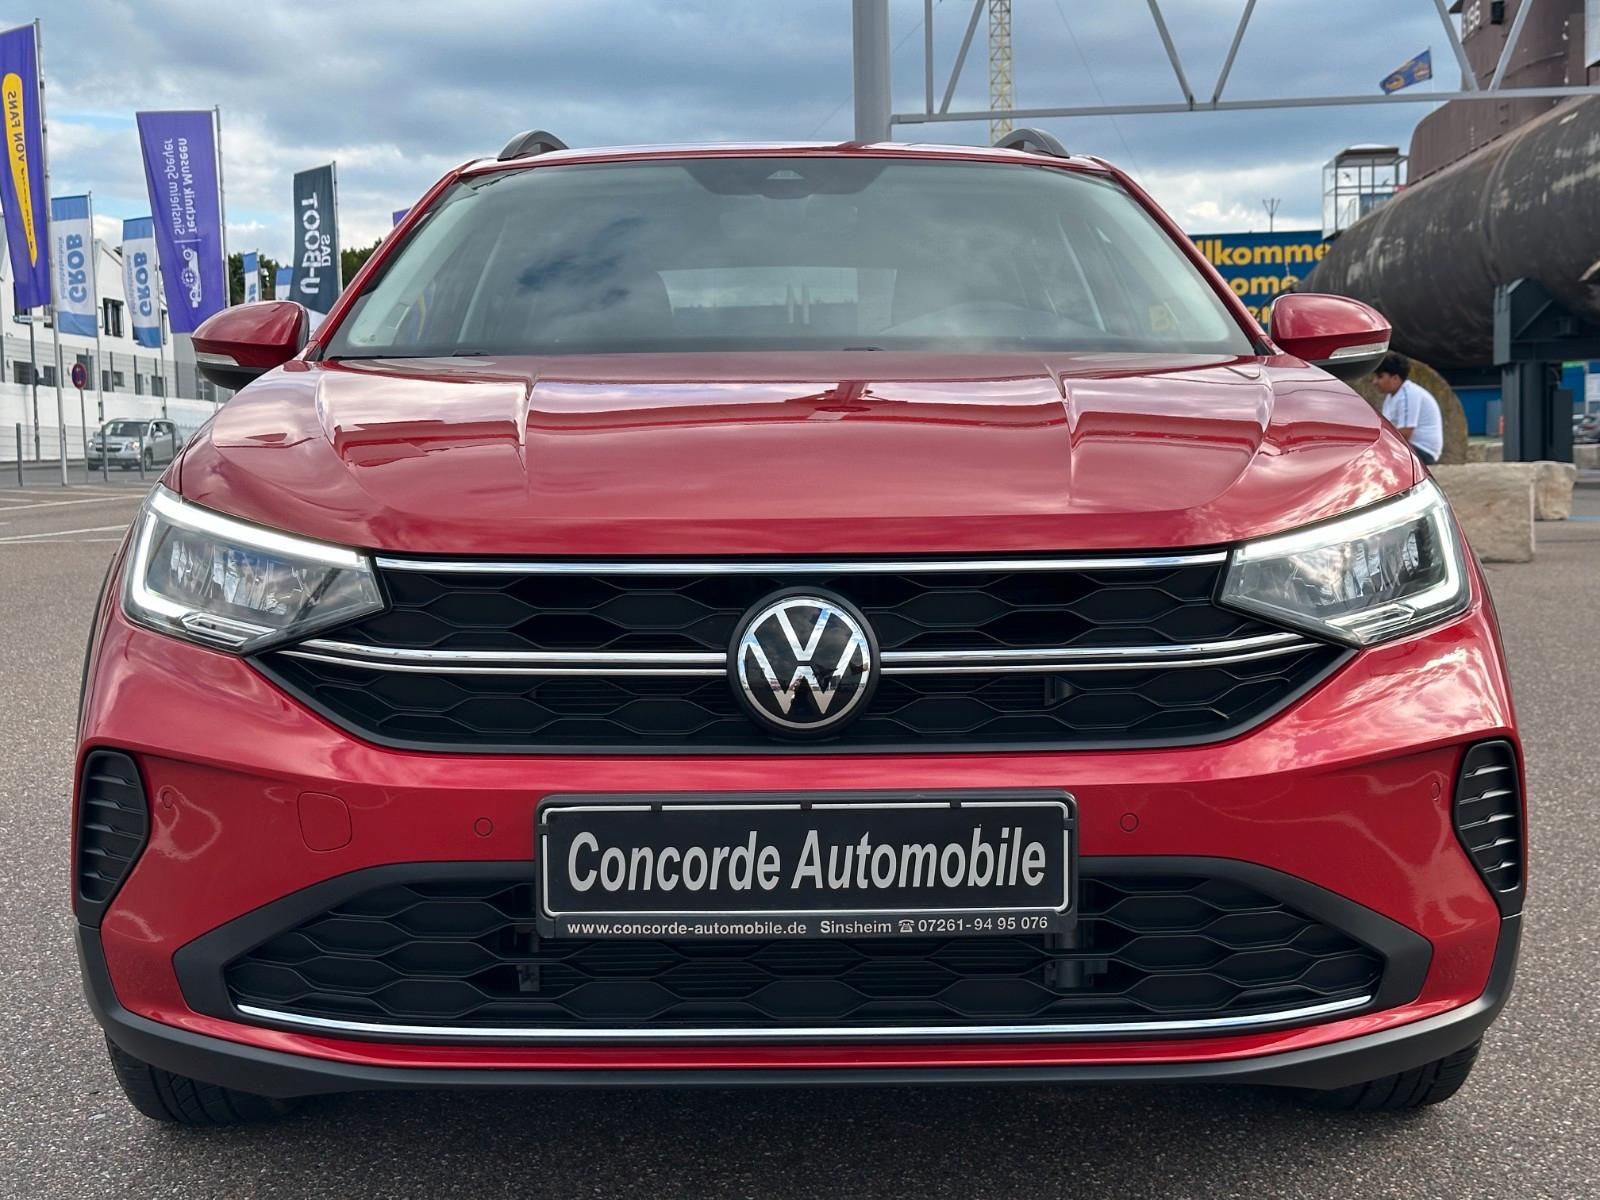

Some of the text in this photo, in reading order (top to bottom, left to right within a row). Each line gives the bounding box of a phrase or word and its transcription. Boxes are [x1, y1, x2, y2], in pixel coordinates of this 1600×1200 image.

[568, 826, 1047, 892] Concorde Automobile
[567, 921, 807, 935] www.concorde-automobile.de
[820, 920, 892, 934] Sinsheim
[997, 916, 1016, 930] 95
[1020, 916, 1048, 930] 076
